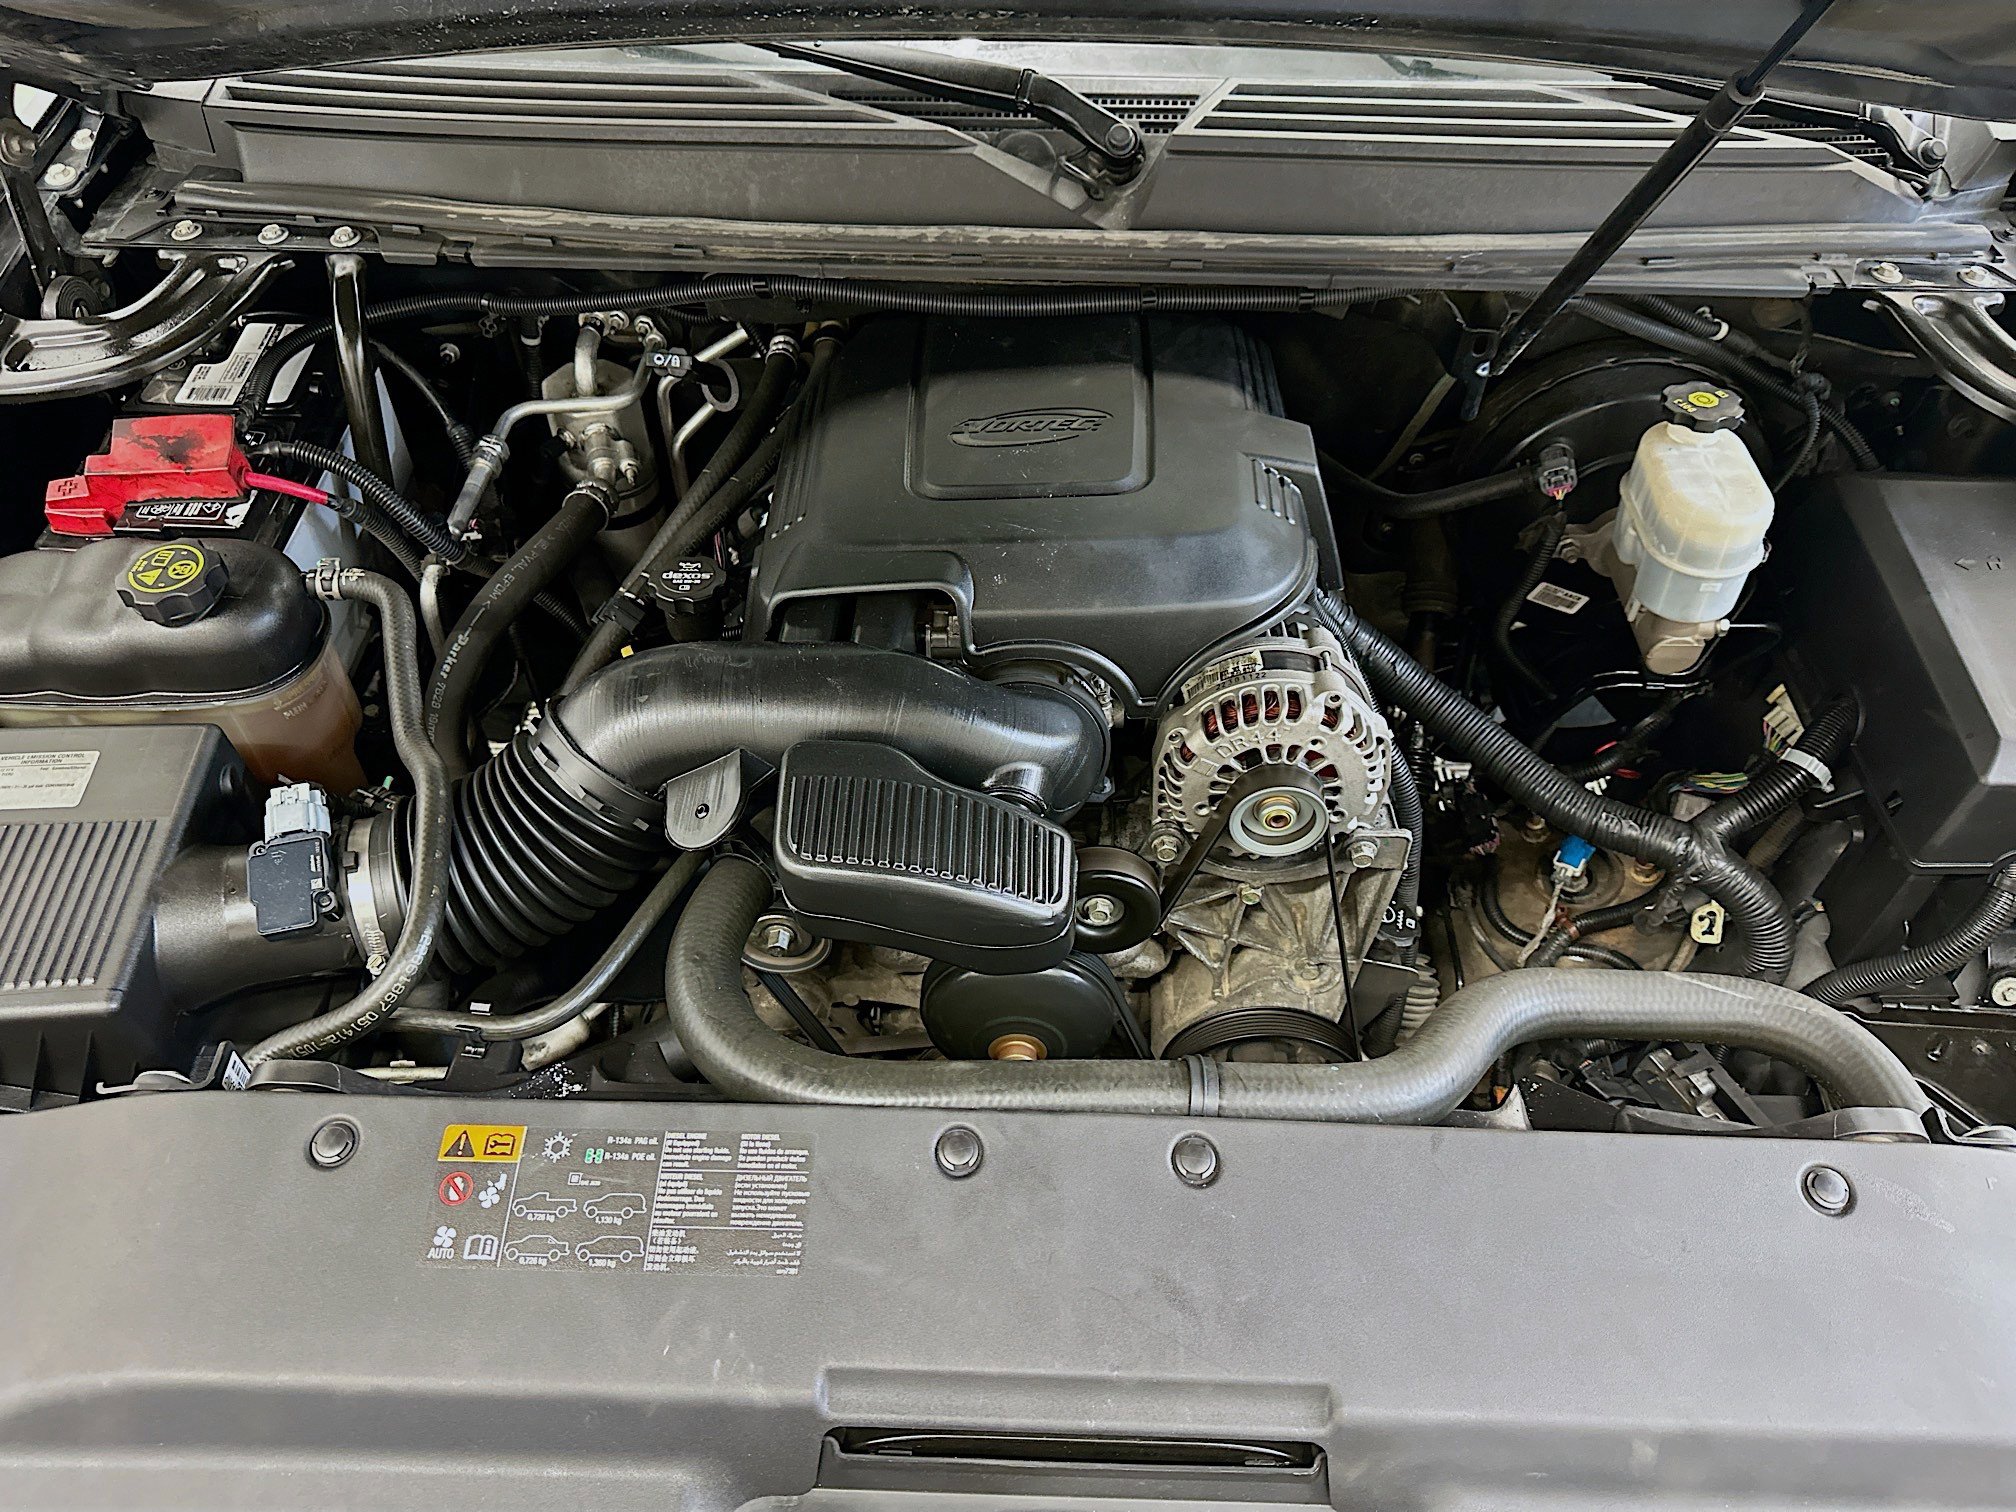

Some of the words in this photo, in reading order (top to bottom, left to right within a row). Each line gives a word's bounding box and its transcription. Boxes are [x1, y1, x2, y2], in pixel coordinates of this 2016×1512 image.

[662, 571, 711, 580] dexos
[439, 634, 470, 679] Parker
[608, 1136, 632, 1144] R-134a
[604, 1152, 629, 1160] R-134a
[545, 1214, 555, 1222] kg
[613, 1217, 622, 1226] kg
[427, 1247, 455, 1260] AUTO
[537, 1258, 548, 1266] kg
[606, 1259, 616, 1268] kg
